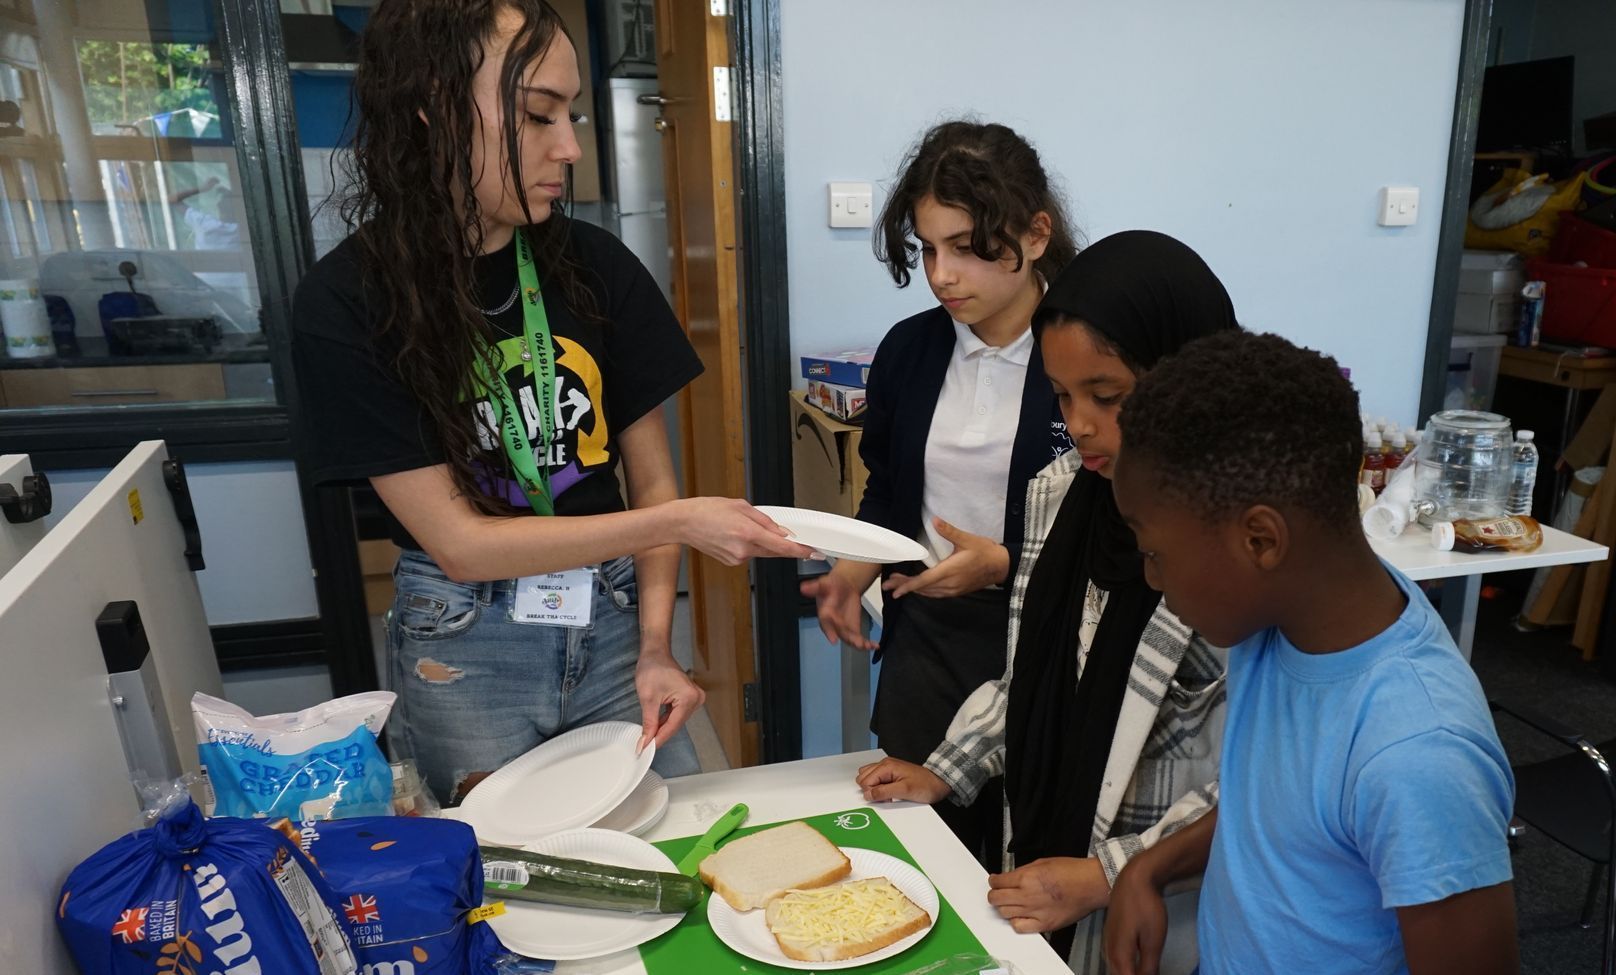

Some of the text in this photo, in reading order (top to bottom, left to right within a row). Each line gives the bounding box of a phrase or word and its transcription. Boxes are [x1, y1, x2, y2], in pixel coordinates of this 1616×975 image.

[535, 332, 549, 378] 1161740
[150, 900, 165, 942] BAKED IN
[162, 899, 177, 940] BRITAIN
[353, 926, 371, 936] KED
[373, 924, 383, 934] IN
[356, 934, 384, 944] ITAIN
